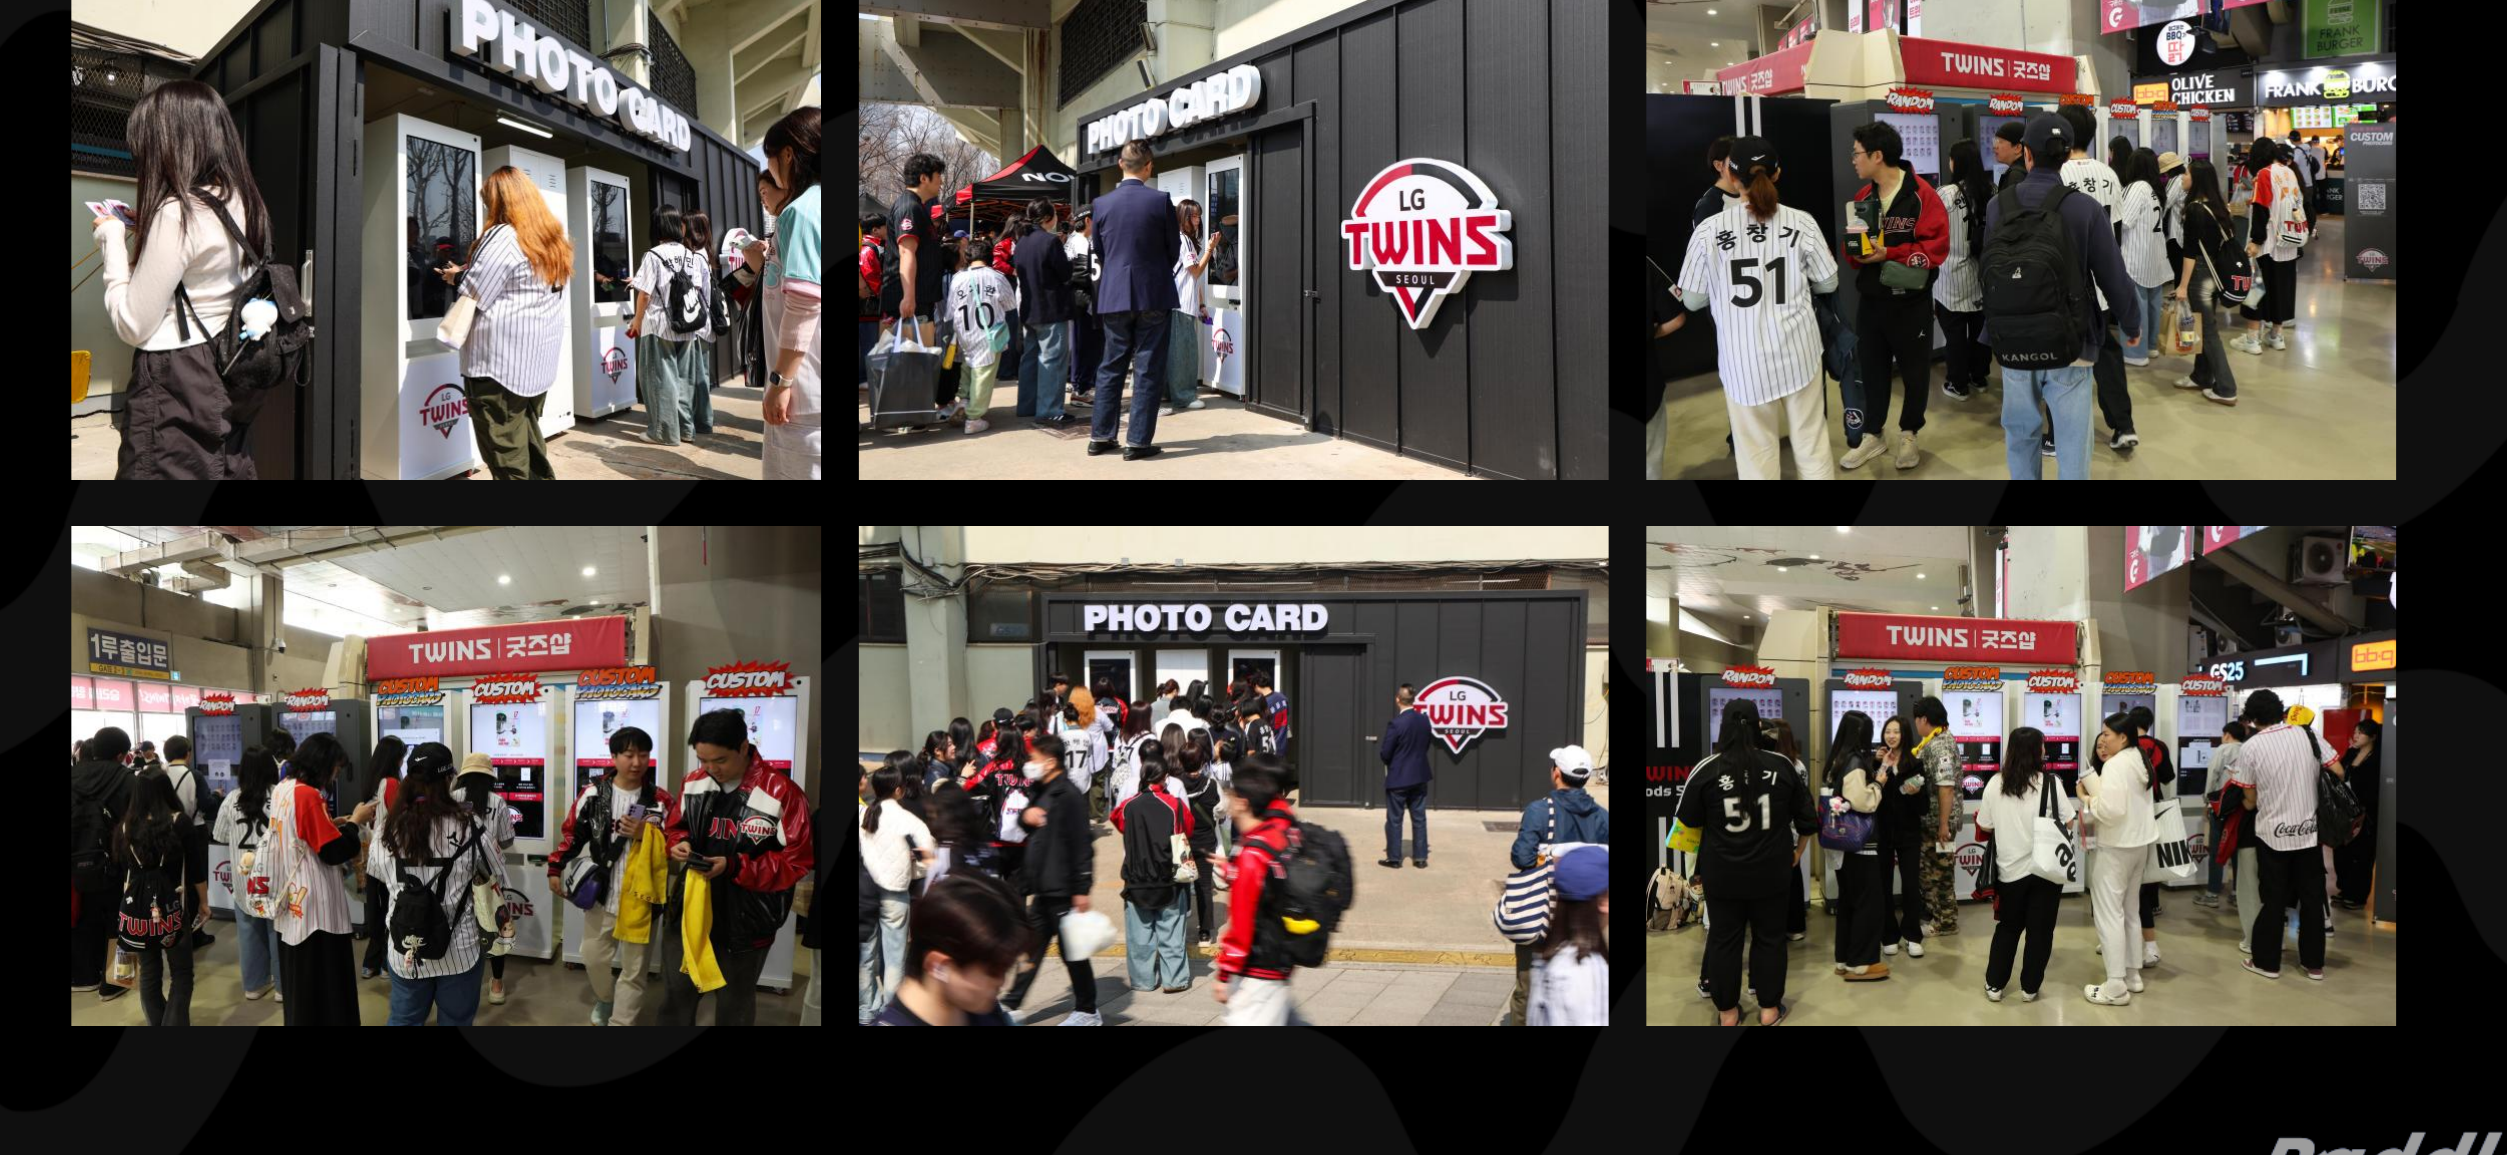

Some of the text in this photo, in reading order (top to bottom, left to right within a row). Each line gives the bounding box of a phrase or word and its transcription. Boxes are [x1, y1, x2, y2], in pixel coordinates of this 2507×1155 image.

[2320, 25, 2360, 39] FRANK
[2317, 37, 2364, 52] BURGER
[1940, 52, 2050, 81] TWINS 굿즈샵
[453, 0, 691, 152] PHOTO CARD
[1750, 68, 1773, 91] 굿즈샵
[2171, 73, 2215, 91] OLIVE
[2171, 88, 2236, 105] CHICKEN
[2265, 81, 2322, 98] FRANK
[1087, 64, 1260, 154] PHOTO CARD
[1886, 92, 1934, 110] RANDOM
[1989, 98, 2023, 113] RANDOM
[2110, 103, 2137, 114] CUSTOM
[2190, 108, 2209, 117] CUSTOM
[2350, 132, 2394, 142] CUSTOM
[1022, 171, 1077, 183] NO
[1399, 188, 1425, 211] LG
[1345, 215, 1498, 265] TWINS
[1715, 223, 1800, 251] 홍창기
[1396, 274, 1435, 285] SEOUL
[1730, 256, 1787, 308] 51
[958, 303, 995, 331] 10
[1211, 339, 1234, 354] TWINS
[2002, 352, 2058, 362] KANGOL
[601, 358, 628, 374] TWINS
[441, 392, 451, 401] LG
[419, 398, 468, 426] TWINS
[1084, 604, 1329, 632] PHOTO CARD
[1886, 626, 2036, 650] TWINS 굿즈샵
[91, 633, 167, 668] 1루출입문
[408, 632, 572, 664] TWINS 굿즈샵
[577, 666, 657, 686] CUSTOM
[706, 671, 786, 689] CUSTOM
[1721, 669, 1775, 685] RANDOM
[1843, 674, 1893, 686] RANDOM
[1944, 667, 2000, 681] CUSTOM
[2104, 671, 2155, 685] CUSTOM
[2210, 661, 2244, 682] GS25
[377, 676, 440, 694] CUSTOM
[474, 681, 535, 698] CUSTOM
[2028, 676, 2075, 688] CUSTOM
[2182, 680, 2223, 691] CUSTOM
[376, 691, 443, 706] PHOTOCARD
[575, 683, 661, 699] PHOTOCARD
[1450, 691, 1467, 701] LG
[199, 700, 236, 712] RANDOM
[285, 694, 330, 708] RANDOM
[1065, 750, 1087, 769] 17
[1718, 770, 1778, 791] 홍기
[1724, 793, 1771, 832] 51
[741, 823, 779, 835] TWINS
[161, 900, 180, 913] LG
[118, 911, 183, 936] TWINS
